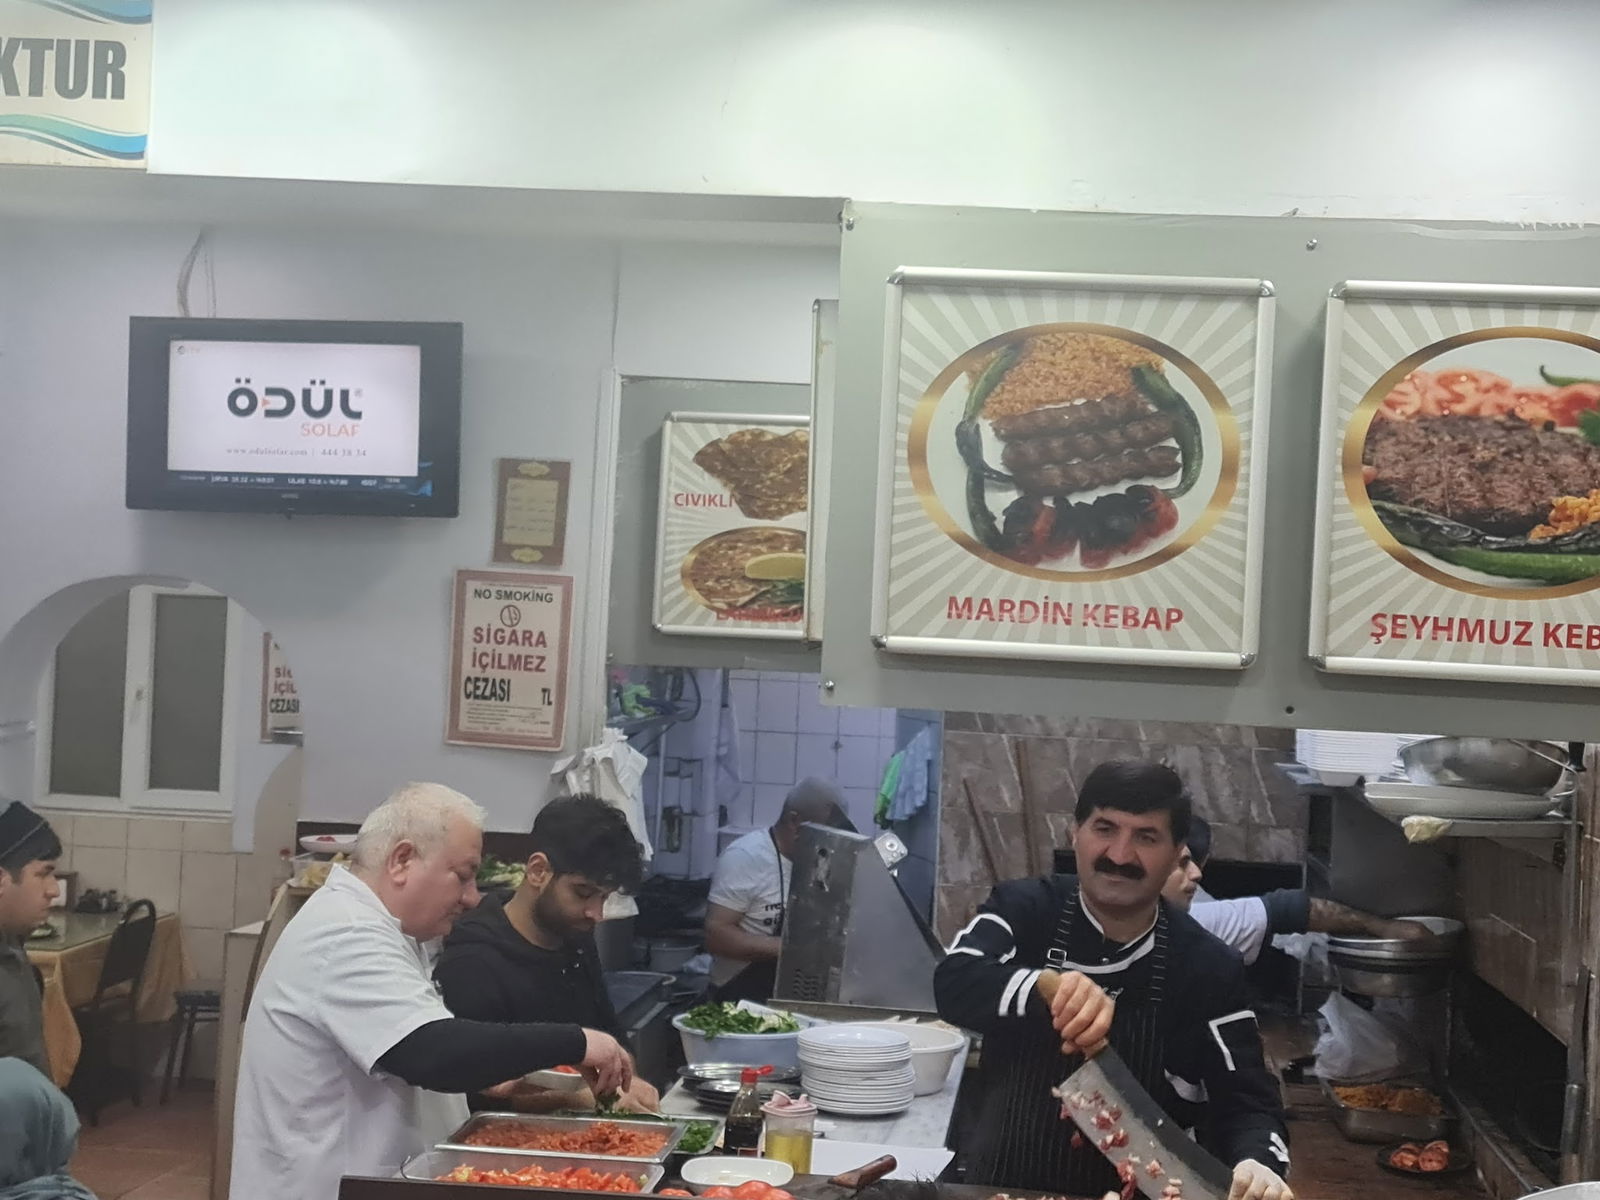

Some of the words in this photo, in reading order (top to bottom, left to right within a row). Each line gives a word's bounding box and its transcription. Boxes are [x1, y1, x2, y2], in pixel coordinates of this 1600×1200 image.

[0, 37, 127, 100] KTUR
[227, 377, 362, 420] ÖDÜL
[474, 588, 491, 600] NO
[947, 595, 1073, 627] MARDİN
[1082, 602, 1184, 632] KEBAP
[473, 623, 547, 648] SİGARA
[1370, 612, 1534, 648] ŞEYHMUZ
[1543, 621, 1600, 651] KEB
[472, 647, 547, 673] İÇİLMEZ
[464, 676, 511, 702] CEZASI
[541, 687, 552, 706] TL
